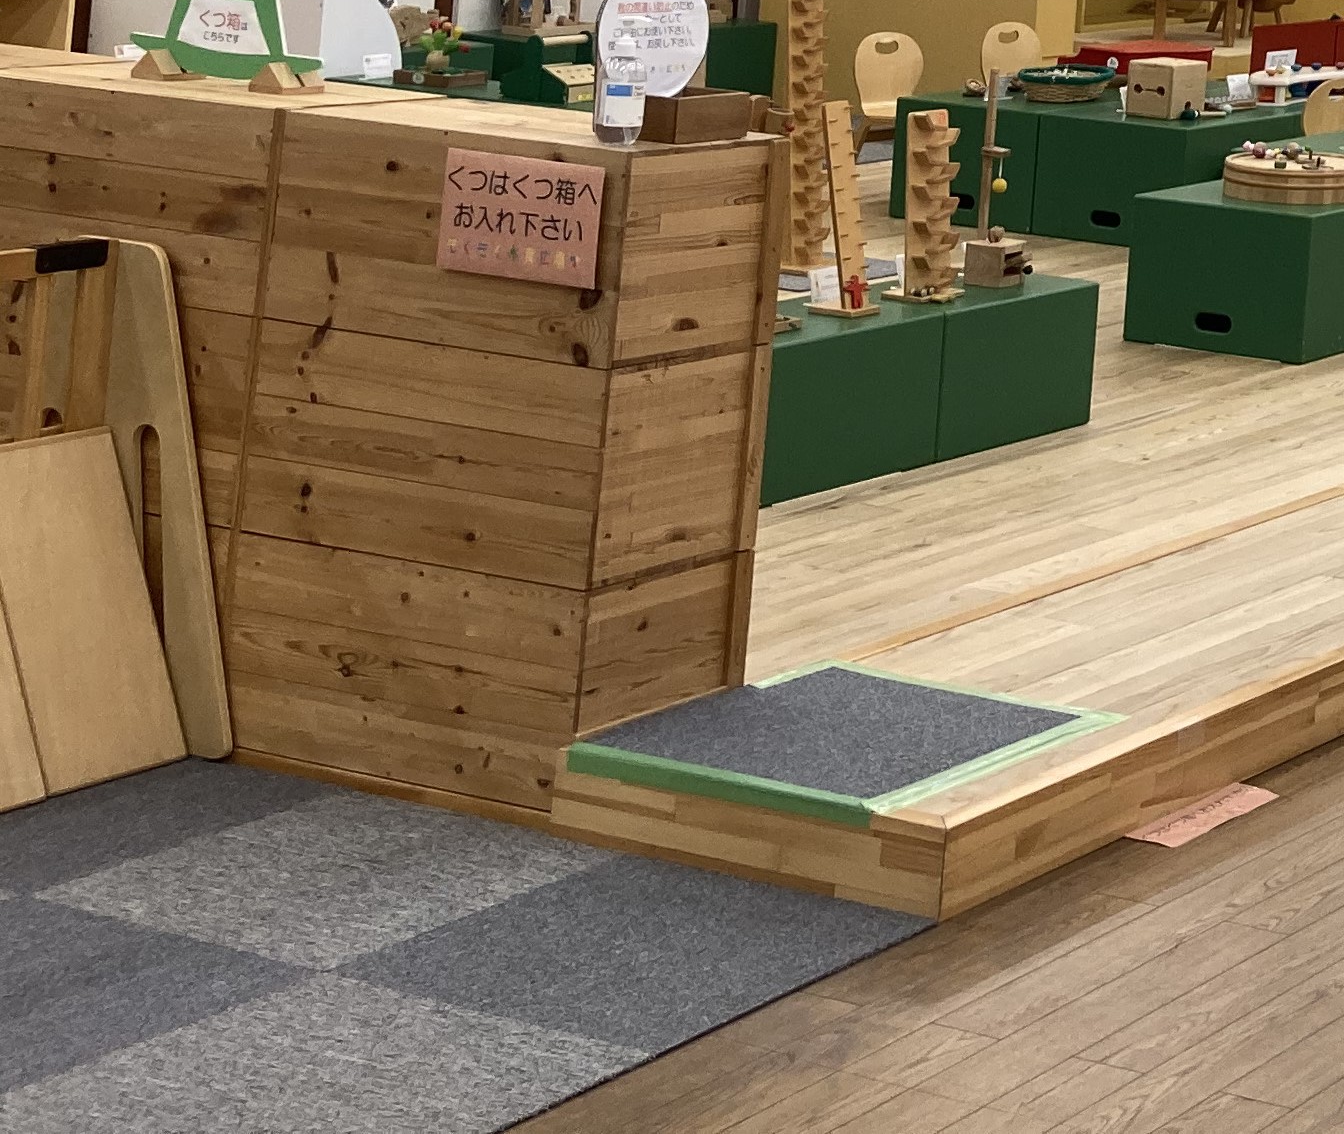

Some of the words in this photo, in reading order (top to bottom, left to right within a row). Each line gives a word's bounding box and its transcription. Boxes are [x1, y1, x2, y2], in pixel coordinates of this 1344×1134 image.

[199, 9, 248, 32] くつ箱は
[203, 30, 240, 44] こちらです
[447, 165, 598, 206] くつはくつ箱へ
[453, 202, 583, 242] お入れ下さい
